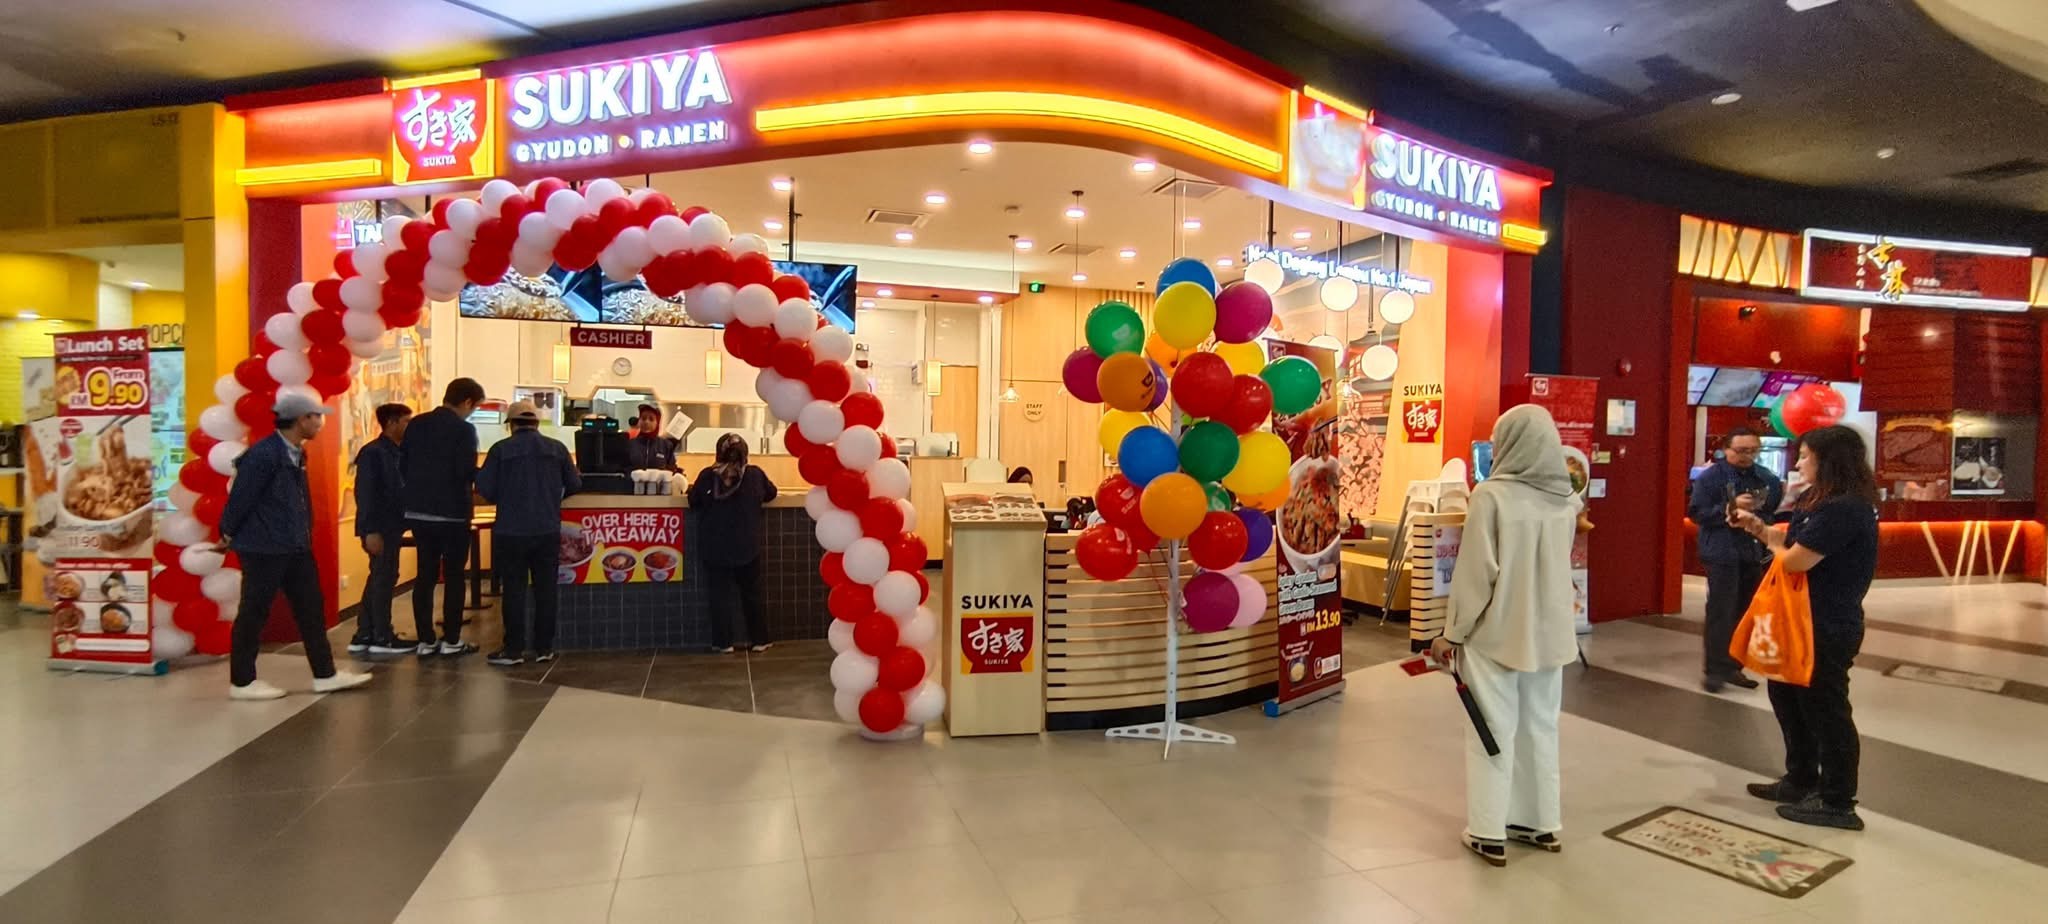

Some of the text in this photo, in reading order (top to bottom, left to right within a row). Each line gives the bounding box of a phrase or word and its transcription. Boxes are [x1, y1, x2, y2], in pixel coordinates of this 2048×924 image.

[512, 51, 731, 129] SUKIYA
[401, 88, 478, 153] すき家
[516, 120, 727, 162] GYUDON RAMEN
[423, 154, 457, 167] SUKIYA
[1370, 133, 1501, 211] SUKIYA
[1371, 190, 1498, 236] GYUDON RAMEN
[67, 336, 144, 353] Lunch Set
[577, 331, 645, 345] CASHIER
[89, 371, 143, 406] 9.90
[1403, 383, 1442, 396] SUKIYA
[582, 512, 680, 529] OVER HERE TO
[582, 526, 680, 545] TAKEAWAY
[961, 594, 1033, 609] SUKIYA
[1315, 609, 1341, 631] 13.90
[967, 619, 1024, 658] すき家
